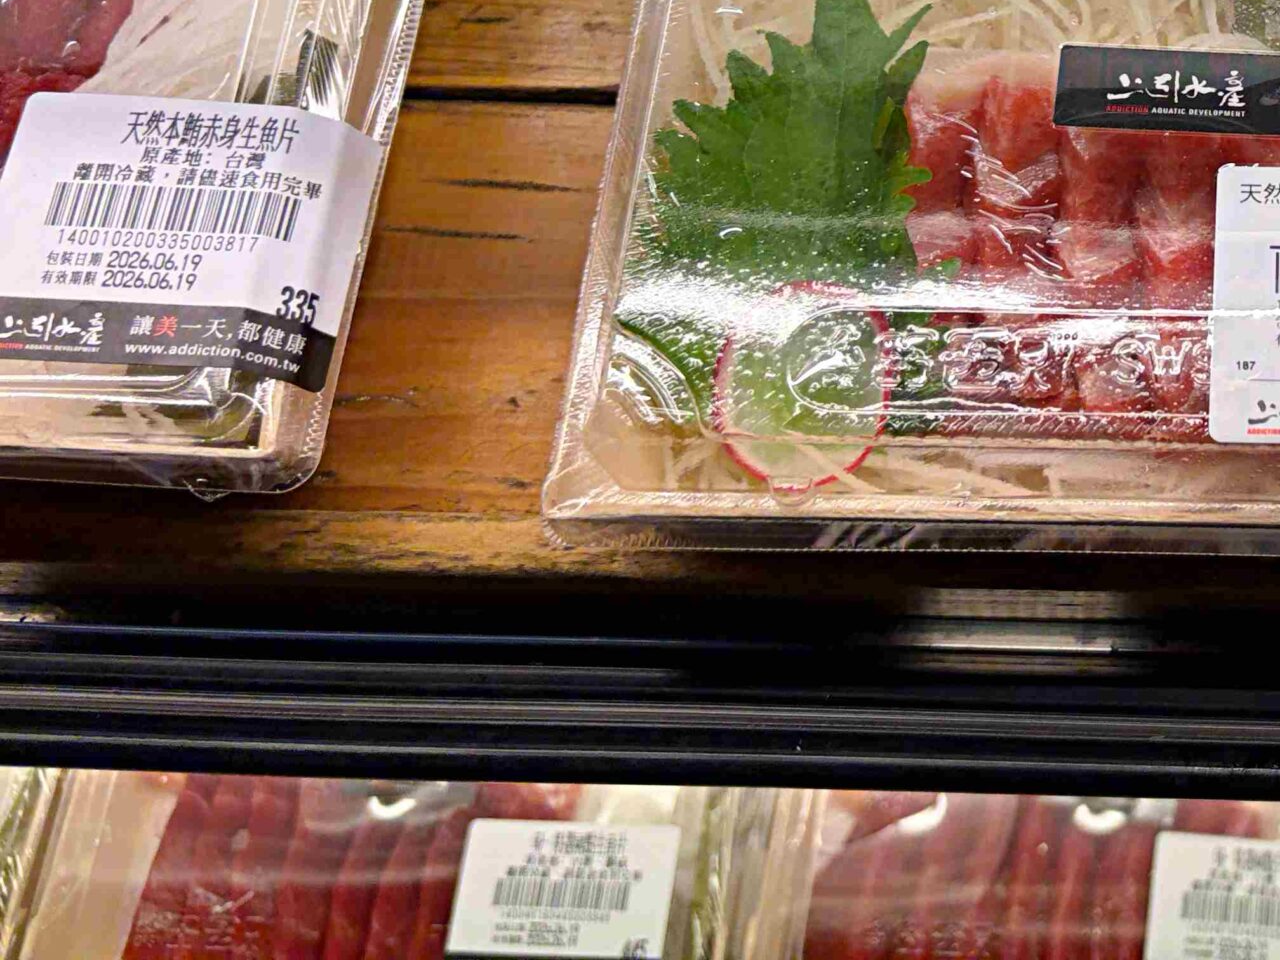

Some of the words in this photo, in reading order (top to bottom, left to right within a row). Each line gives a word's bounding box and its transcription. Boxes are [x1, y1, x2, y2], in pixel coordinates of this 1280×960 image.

[1105, 104, 1149, 113] ADDICTION
[1151, 106, 1186, 115] AQUATIC
[1188, 108, 1246, 118] DEVELOPMENT
[120, 110, 300, 155] 天然本鮪赤身生魚片
[57, 228, 259, 252] 140010200335003817
[46, 251, 103, 267] 包裝日期
[107, 251, 203, 272] 2026.06.19
[40, 270, 97, 287] 有效期限
[101, 270, 197, 291] 2026.06.19
[276, 286, 320, 326] 335
[125, 342, 301, 373] www.addiction.com.tw
[1236, 361, 1256, 371] 187
